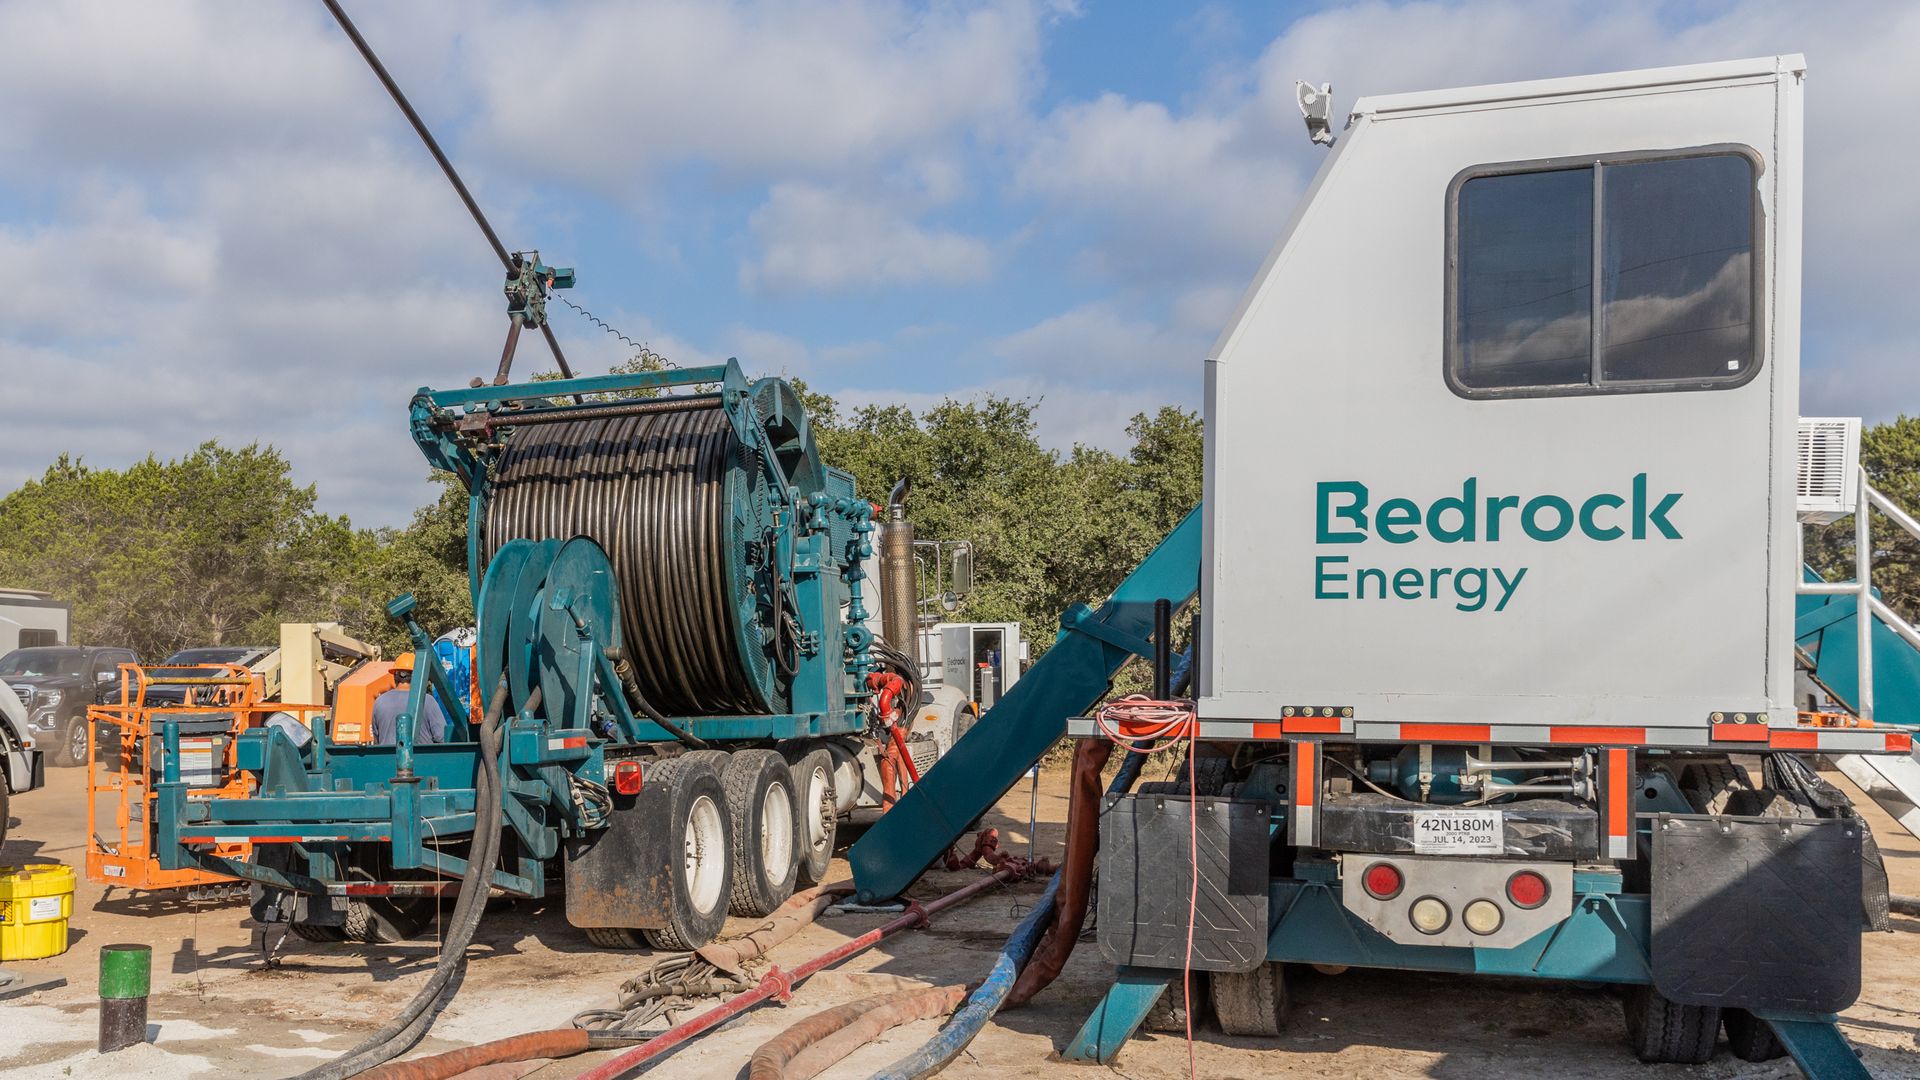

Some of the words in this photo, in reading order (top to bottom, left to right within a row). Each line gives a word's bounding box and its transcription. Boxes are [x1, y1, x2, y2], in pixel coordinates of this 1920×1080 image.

[1315, 472, 1684, 544] Bedrock
[1315, 555, 1529, 612] Energy
[1421, 819, 1494, 831] 42N180M
[1452, 836, 1466, 844] 14,
